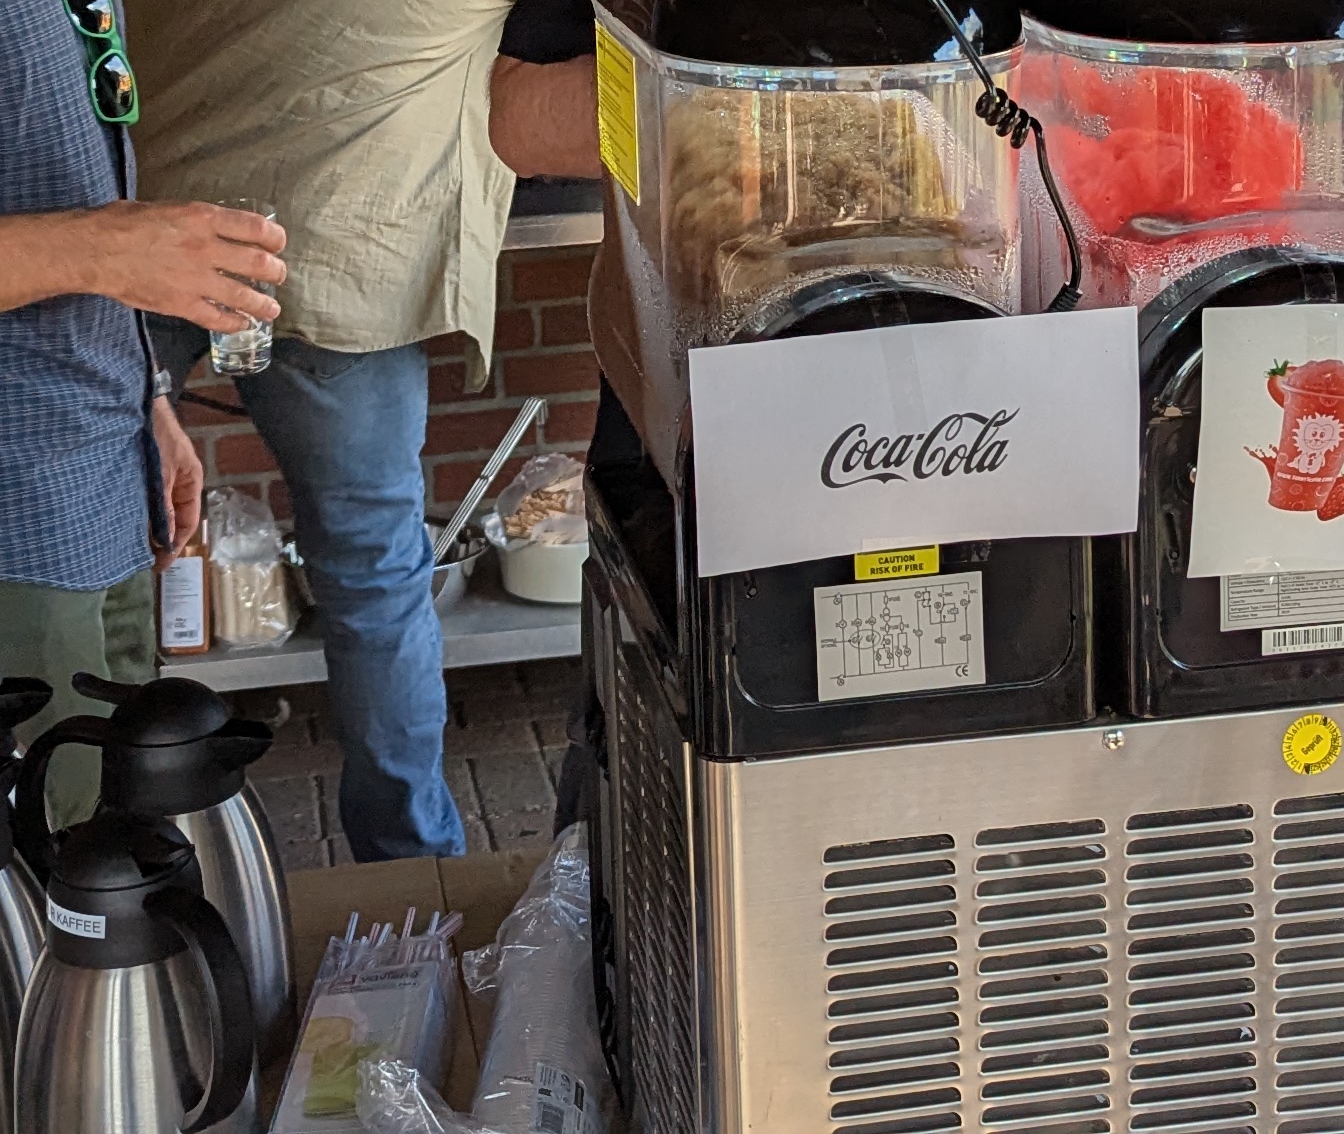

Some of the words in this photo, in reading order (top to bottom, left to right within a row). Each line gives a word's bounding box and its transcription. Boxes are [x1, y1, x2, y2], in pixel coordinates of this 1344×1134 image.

[821, 407, 1021, 489] Coca-Cola
[878, 554, 915, 565] CAUTION
[870, 566, 890, 575] RISK
[892, 565, 902, 573] OF
[904, 563, 924, 572] FIRE
[56, 911, 101, 934] KAFFEE
